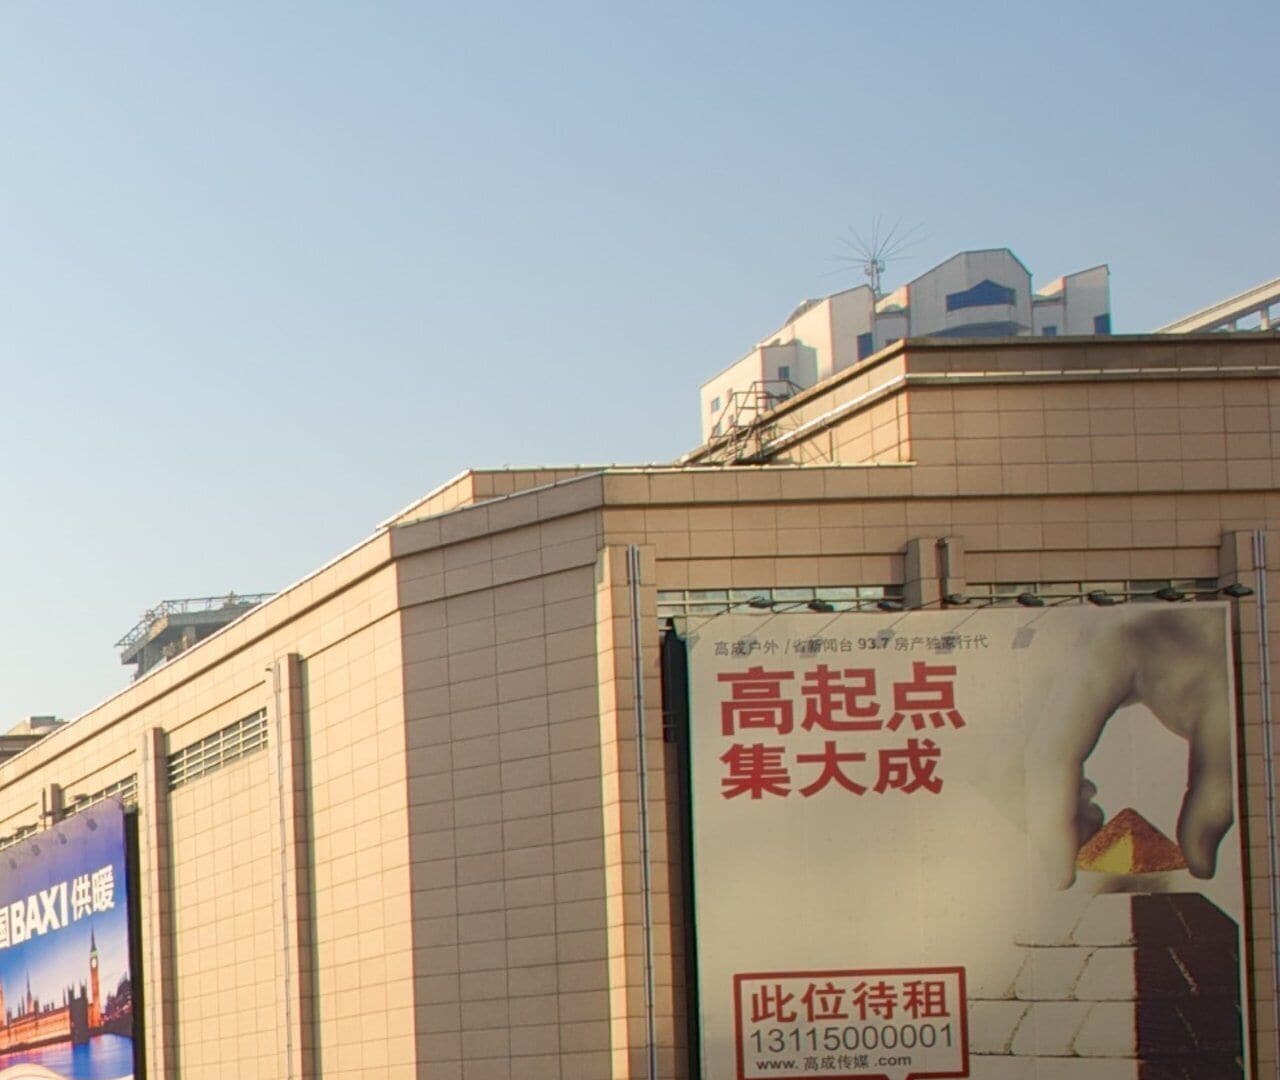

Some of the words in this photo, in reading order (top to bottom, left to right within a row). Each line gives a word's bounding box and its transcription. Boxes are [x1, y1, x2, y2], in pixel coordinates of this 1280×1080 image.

[857, 637, 890, 652] 93.7
[716, 661, 966, 736] 高起点
[720, 738, 945, 800] 集大成
[750, 979, 951, 1024] 此位待租
[751, 1023, 953, 1054] 13115000001
